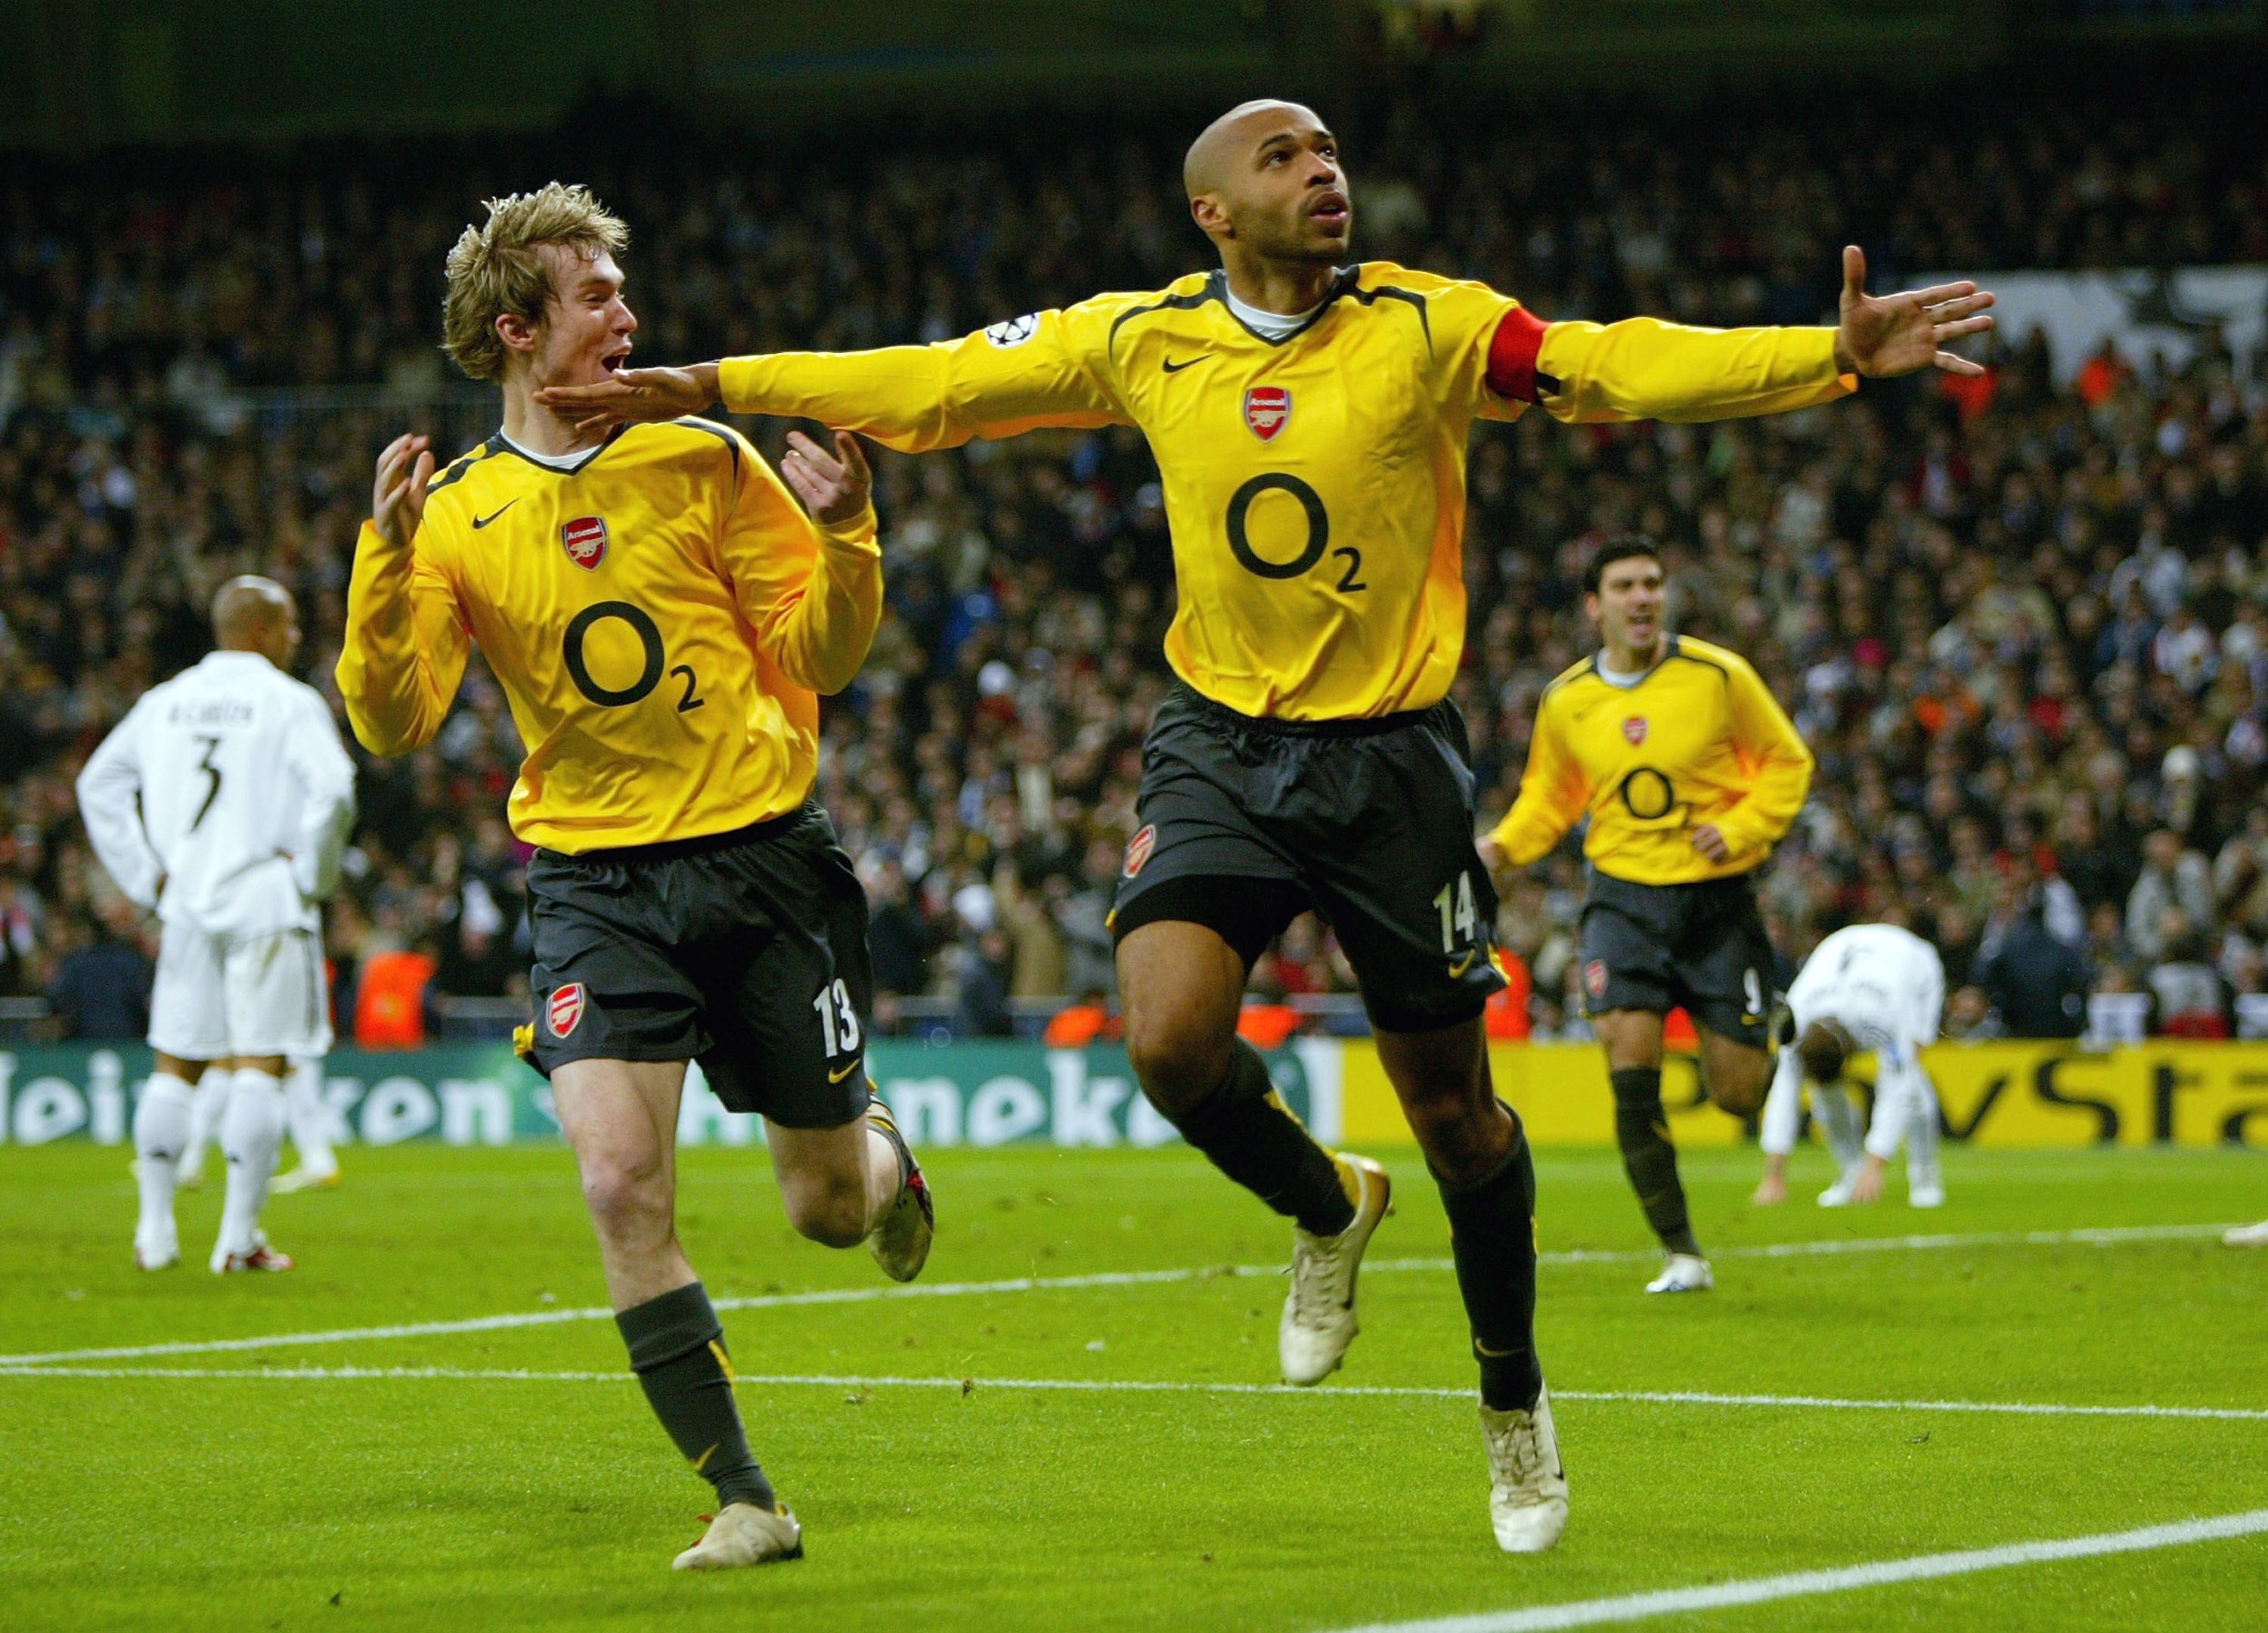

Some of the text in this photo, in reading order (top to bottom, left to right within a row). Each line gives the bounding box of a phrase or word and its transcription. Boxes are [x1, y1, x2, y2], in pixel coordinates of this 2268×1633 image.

[190, 733, 222, 835] 3
[1432, 870, 1475, 954] 14
[813, 978, 860, 1058] 13
